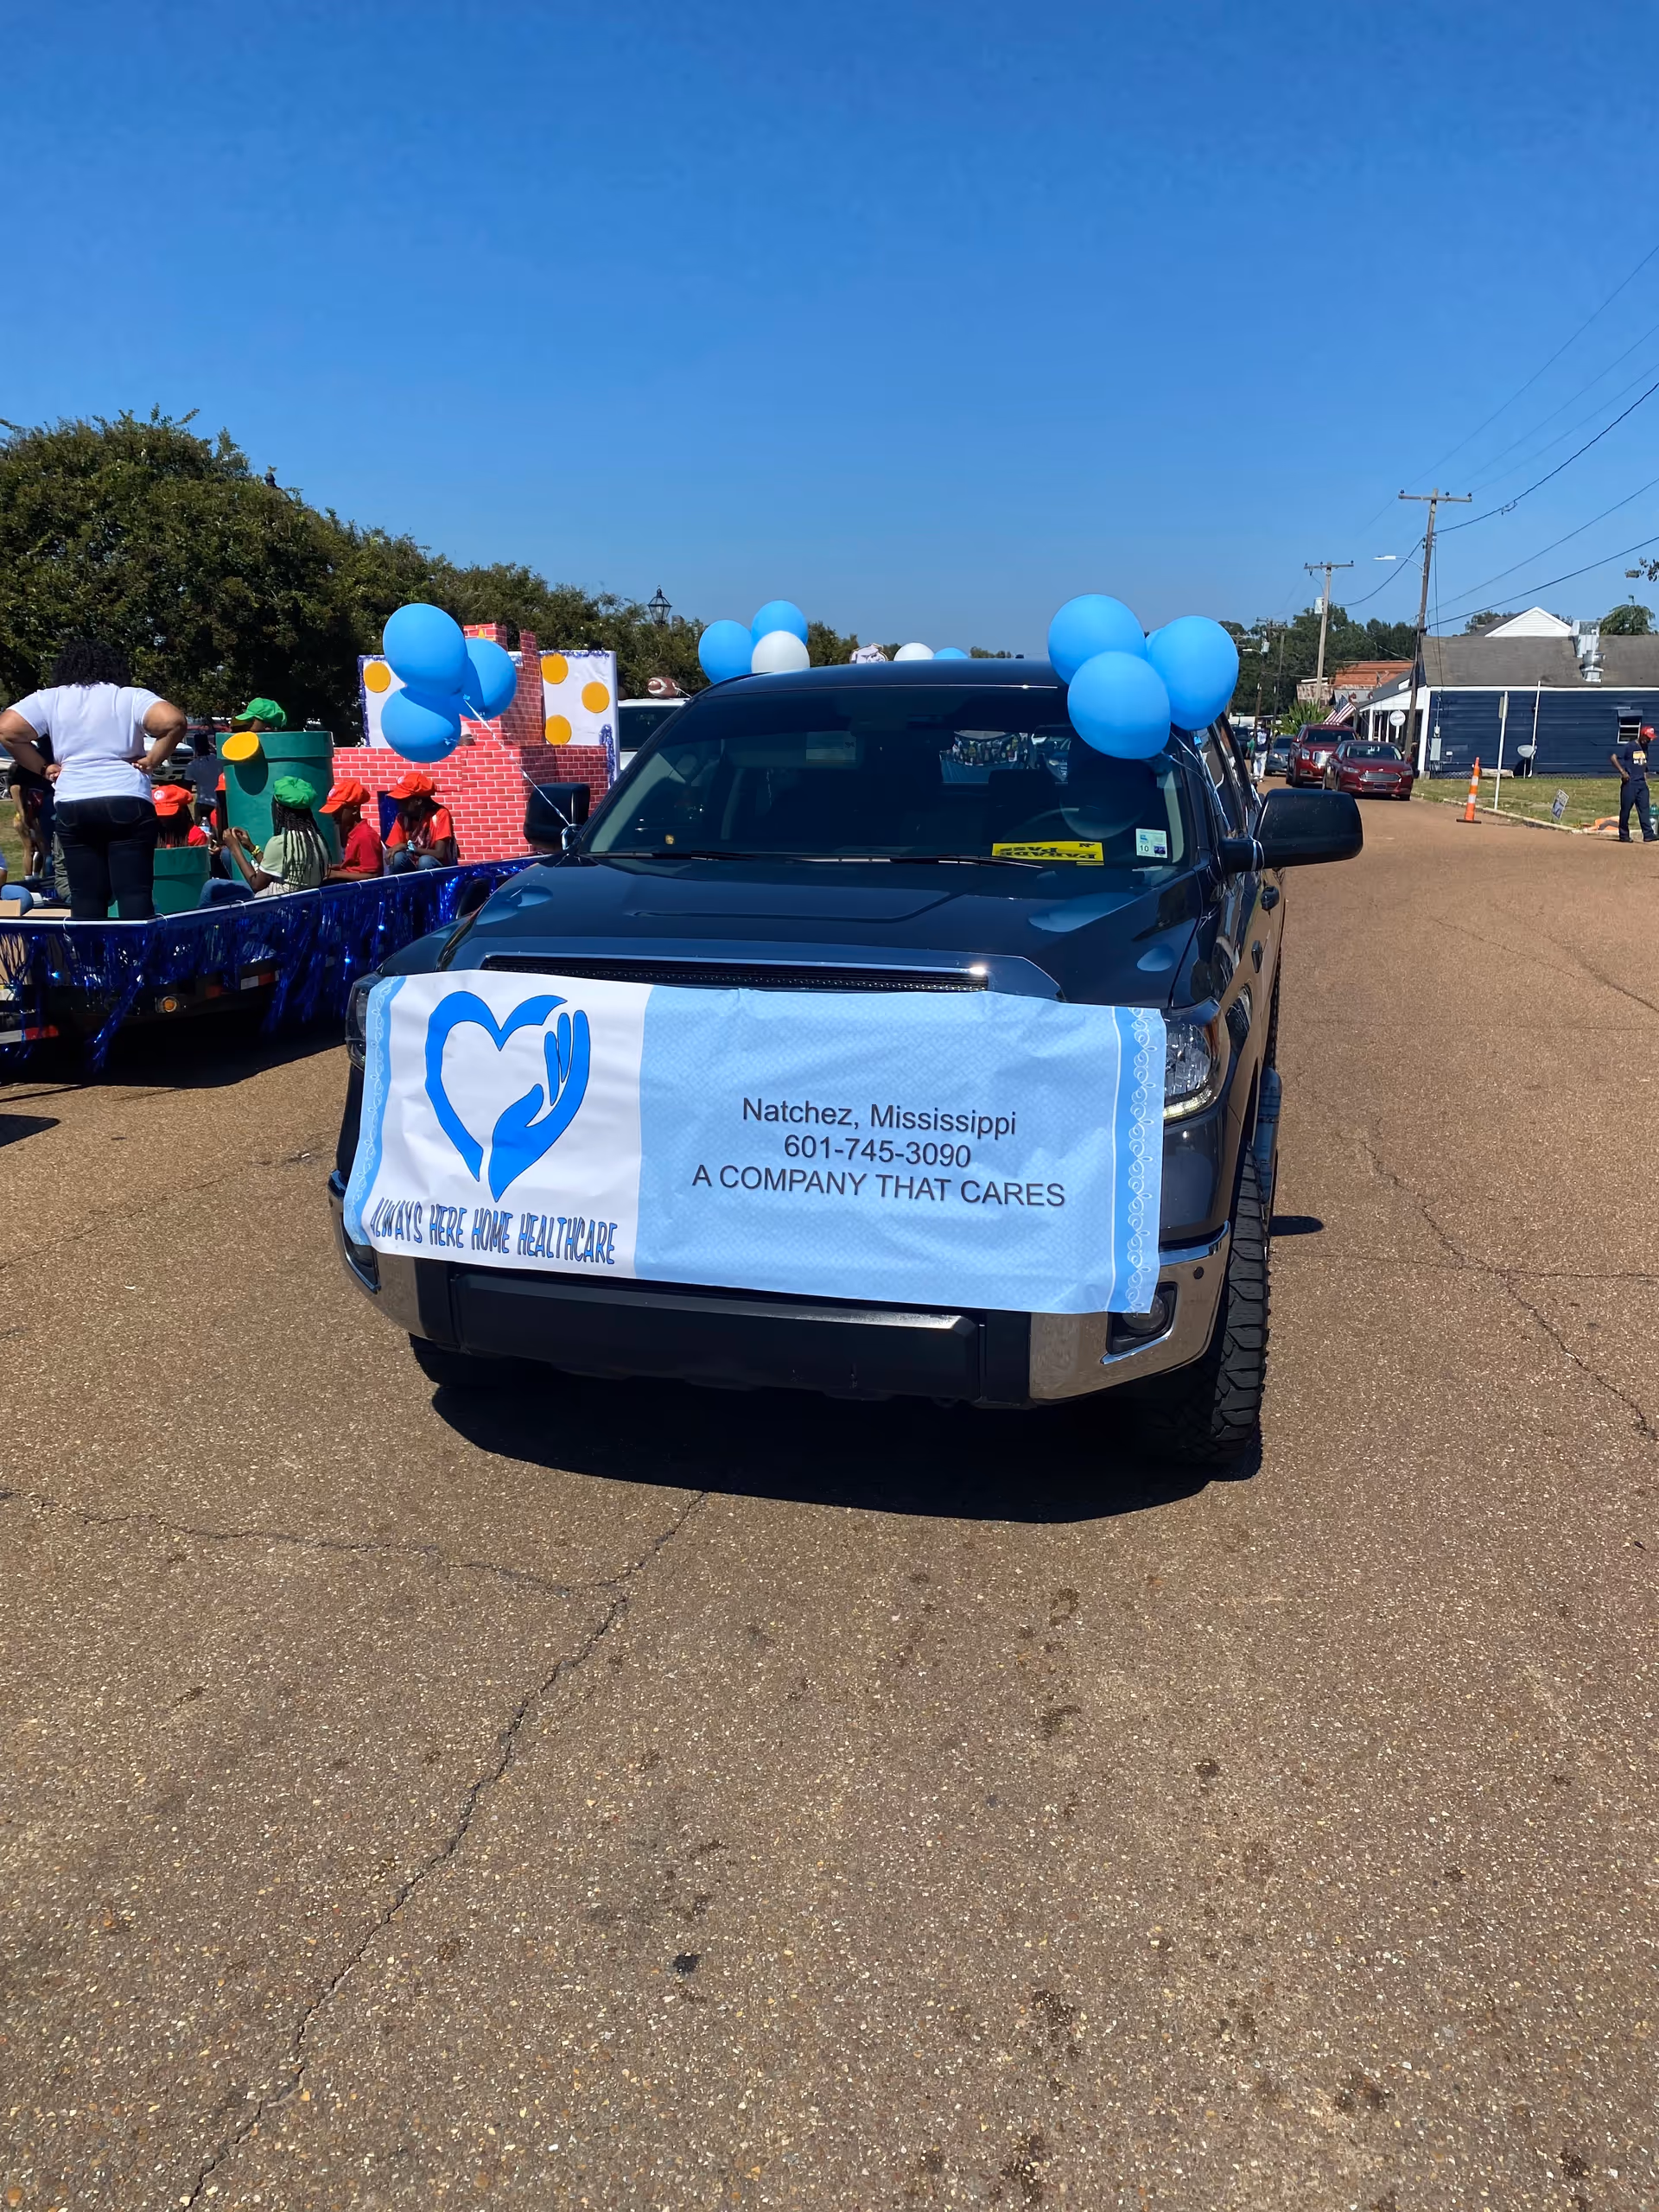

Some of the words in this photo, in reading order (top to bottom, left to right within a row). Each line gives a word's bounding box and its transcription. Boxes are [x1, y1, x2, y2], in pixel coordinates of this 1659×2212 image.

[742, 1097, 859, 1129] Natchez,
[870, 1103, 1017, 1140] Mississippi
[784, 1135, 971, 1167] 601-745-3090
[692, 1165, 712, 1187] A
[719, 1165, 867, 1197] COMPANY
[875, 1173, 951, 1202] THAT
[960, 1180, 1065, 1207] CARES
[370, 1197, 423, 1243] ALWAYS
[429, 1204, 467, 1248] HERE
[471, 1208, 513, 1254] HOME
[518, 1212, 619, 1265] HEALTHCARE
